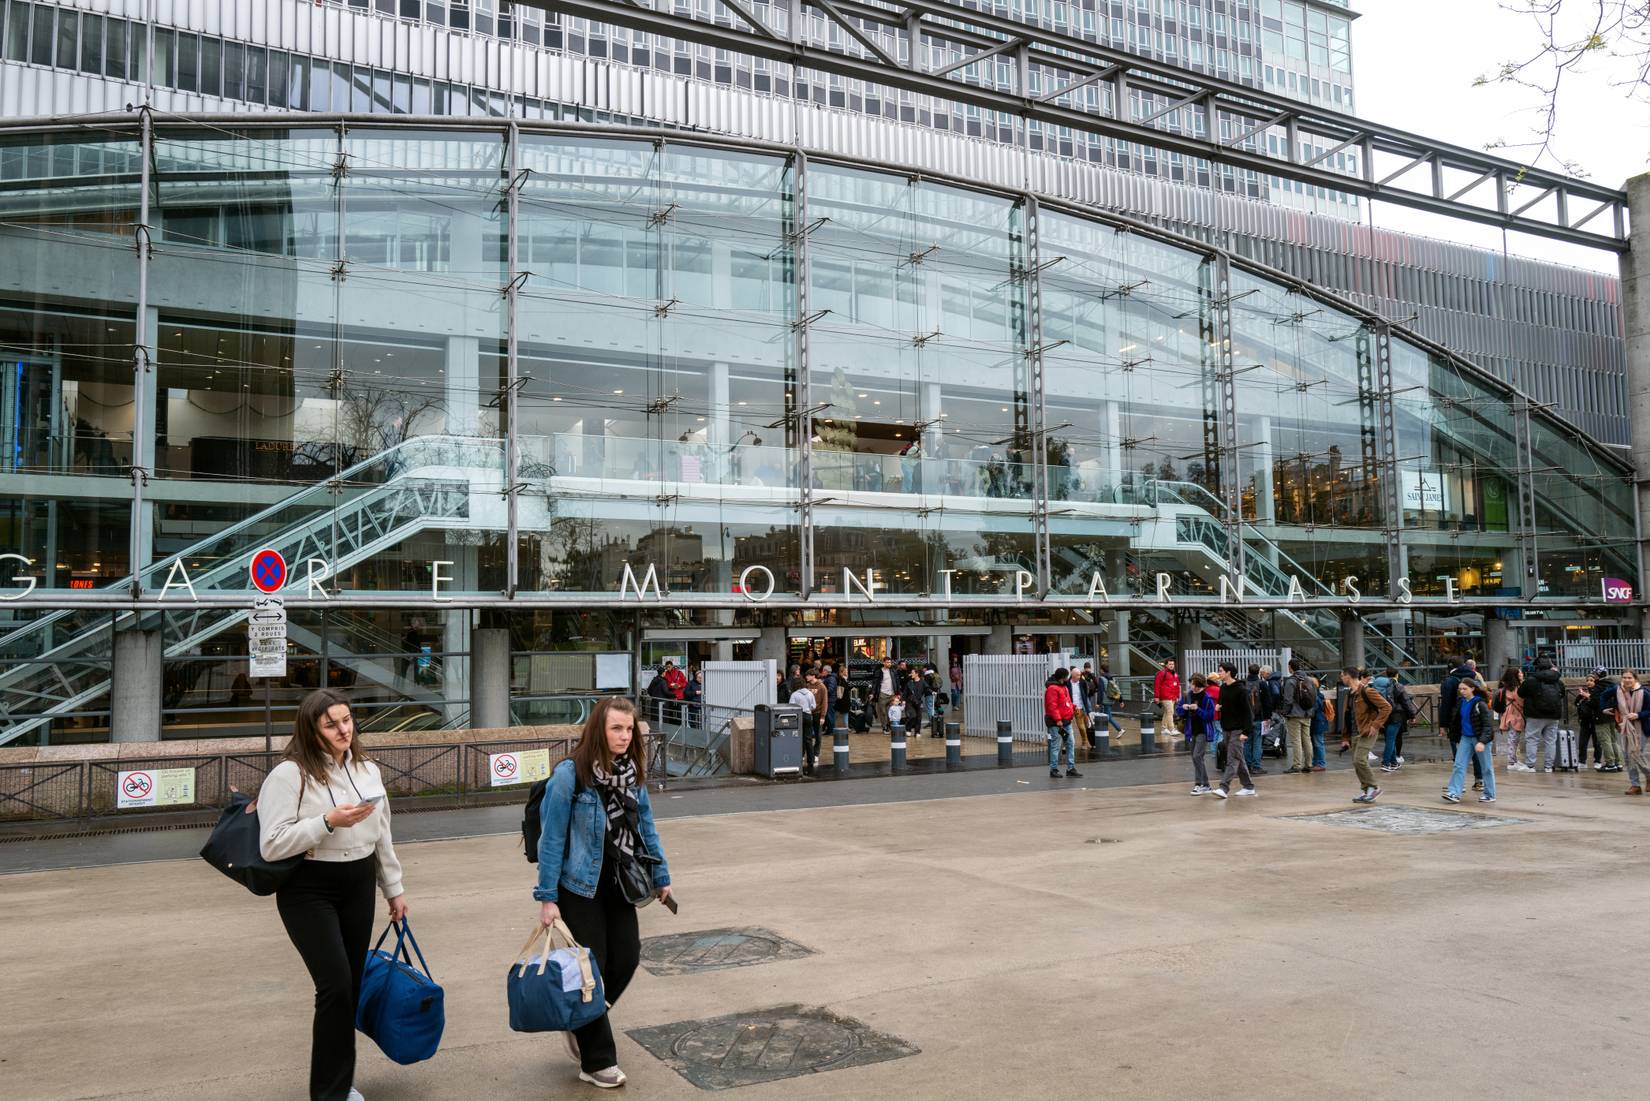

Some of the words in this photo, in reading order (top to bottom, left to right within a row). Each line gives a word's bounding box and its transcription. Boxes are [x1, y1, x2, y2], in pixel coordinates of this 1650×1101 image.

[1425, 493, 1441, 502] JAME
[0, 554, 455, 601] GARE
[619, 562, 1460, 604] MONTPARNASSE
[1607, 587, 1633, 600] SNCF
